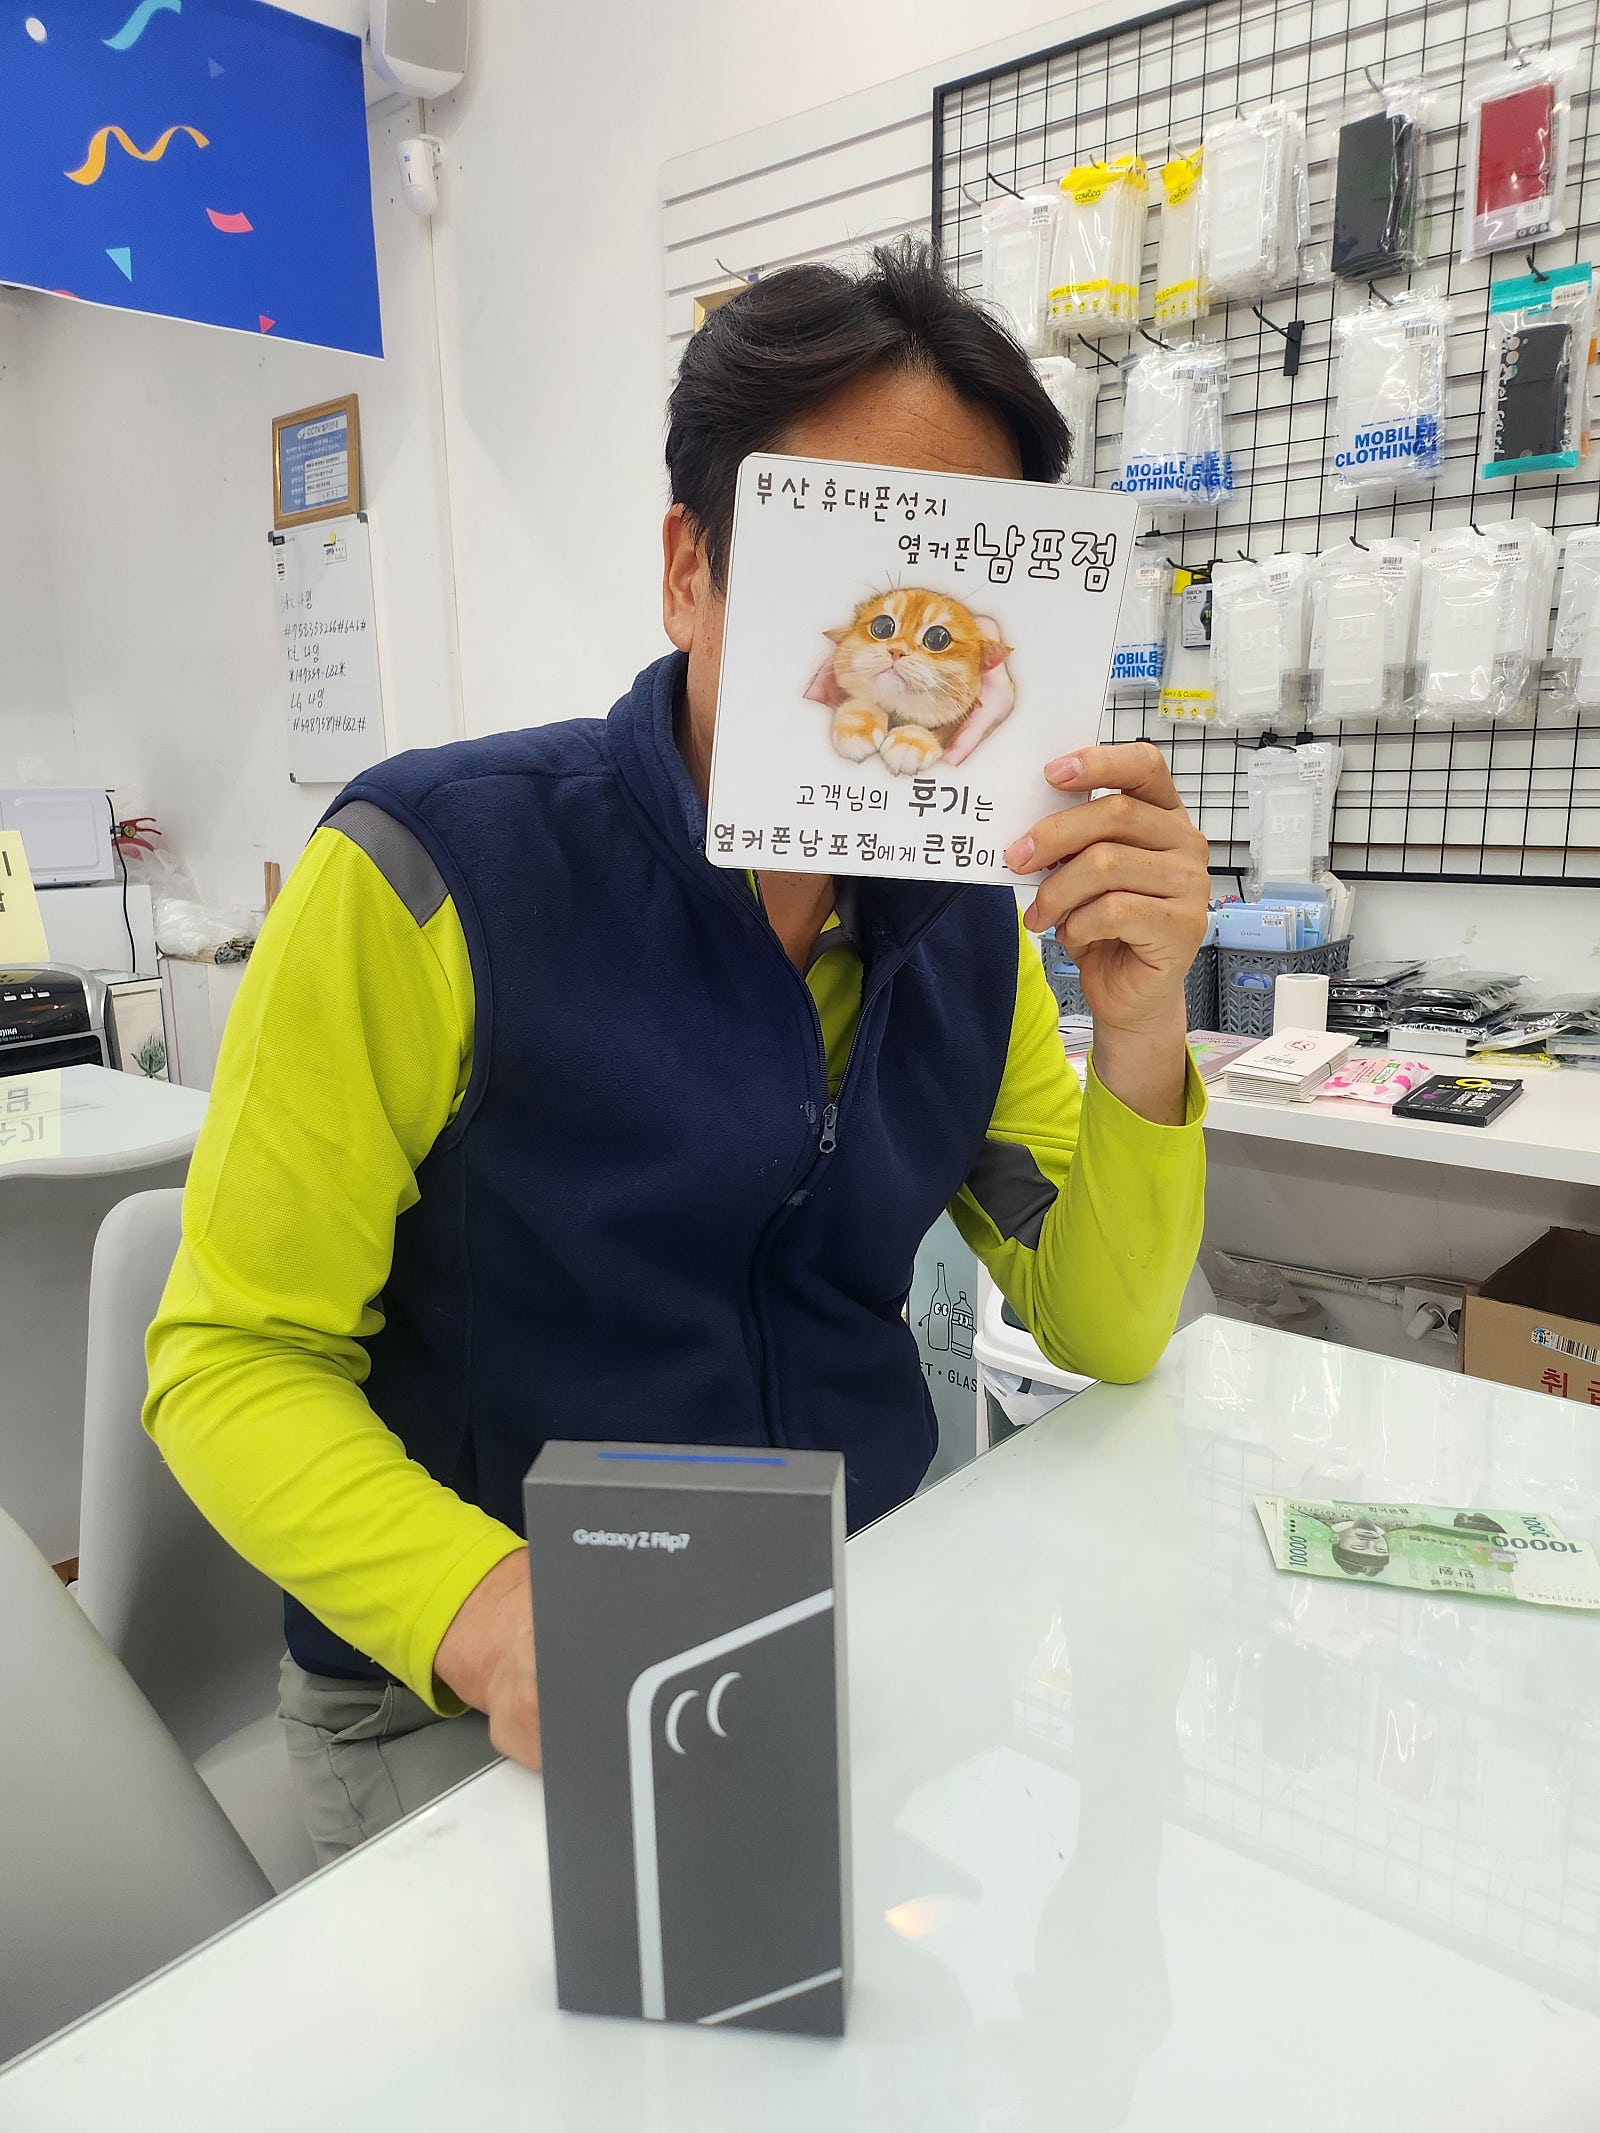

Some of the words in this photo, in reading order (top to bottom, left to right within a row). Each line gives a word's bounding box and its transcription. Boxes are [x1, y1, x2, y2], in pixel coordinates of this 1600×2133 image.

[1355, 423, 1427, 449] MOBILE
[1335, 440, 1427, 468] CLOTHING
[1126, 460, 1186, 478] MOBILE
[757, 472, 810, 510] 부산
[821, 478, 947, 523] 휴대폰성지
[796, 784, 889, 813] 고객님의
[907, 777, 995, 823] 후기는
[572, 1528, 638, 1551] Galaxy
[637, 1531, 651, 1549] Z
[650, 1531, 691, 1553] Flip7
[1289, 1535, 1308, 1567] 10000
[1490, 1535, 1584, 1554] 10000
